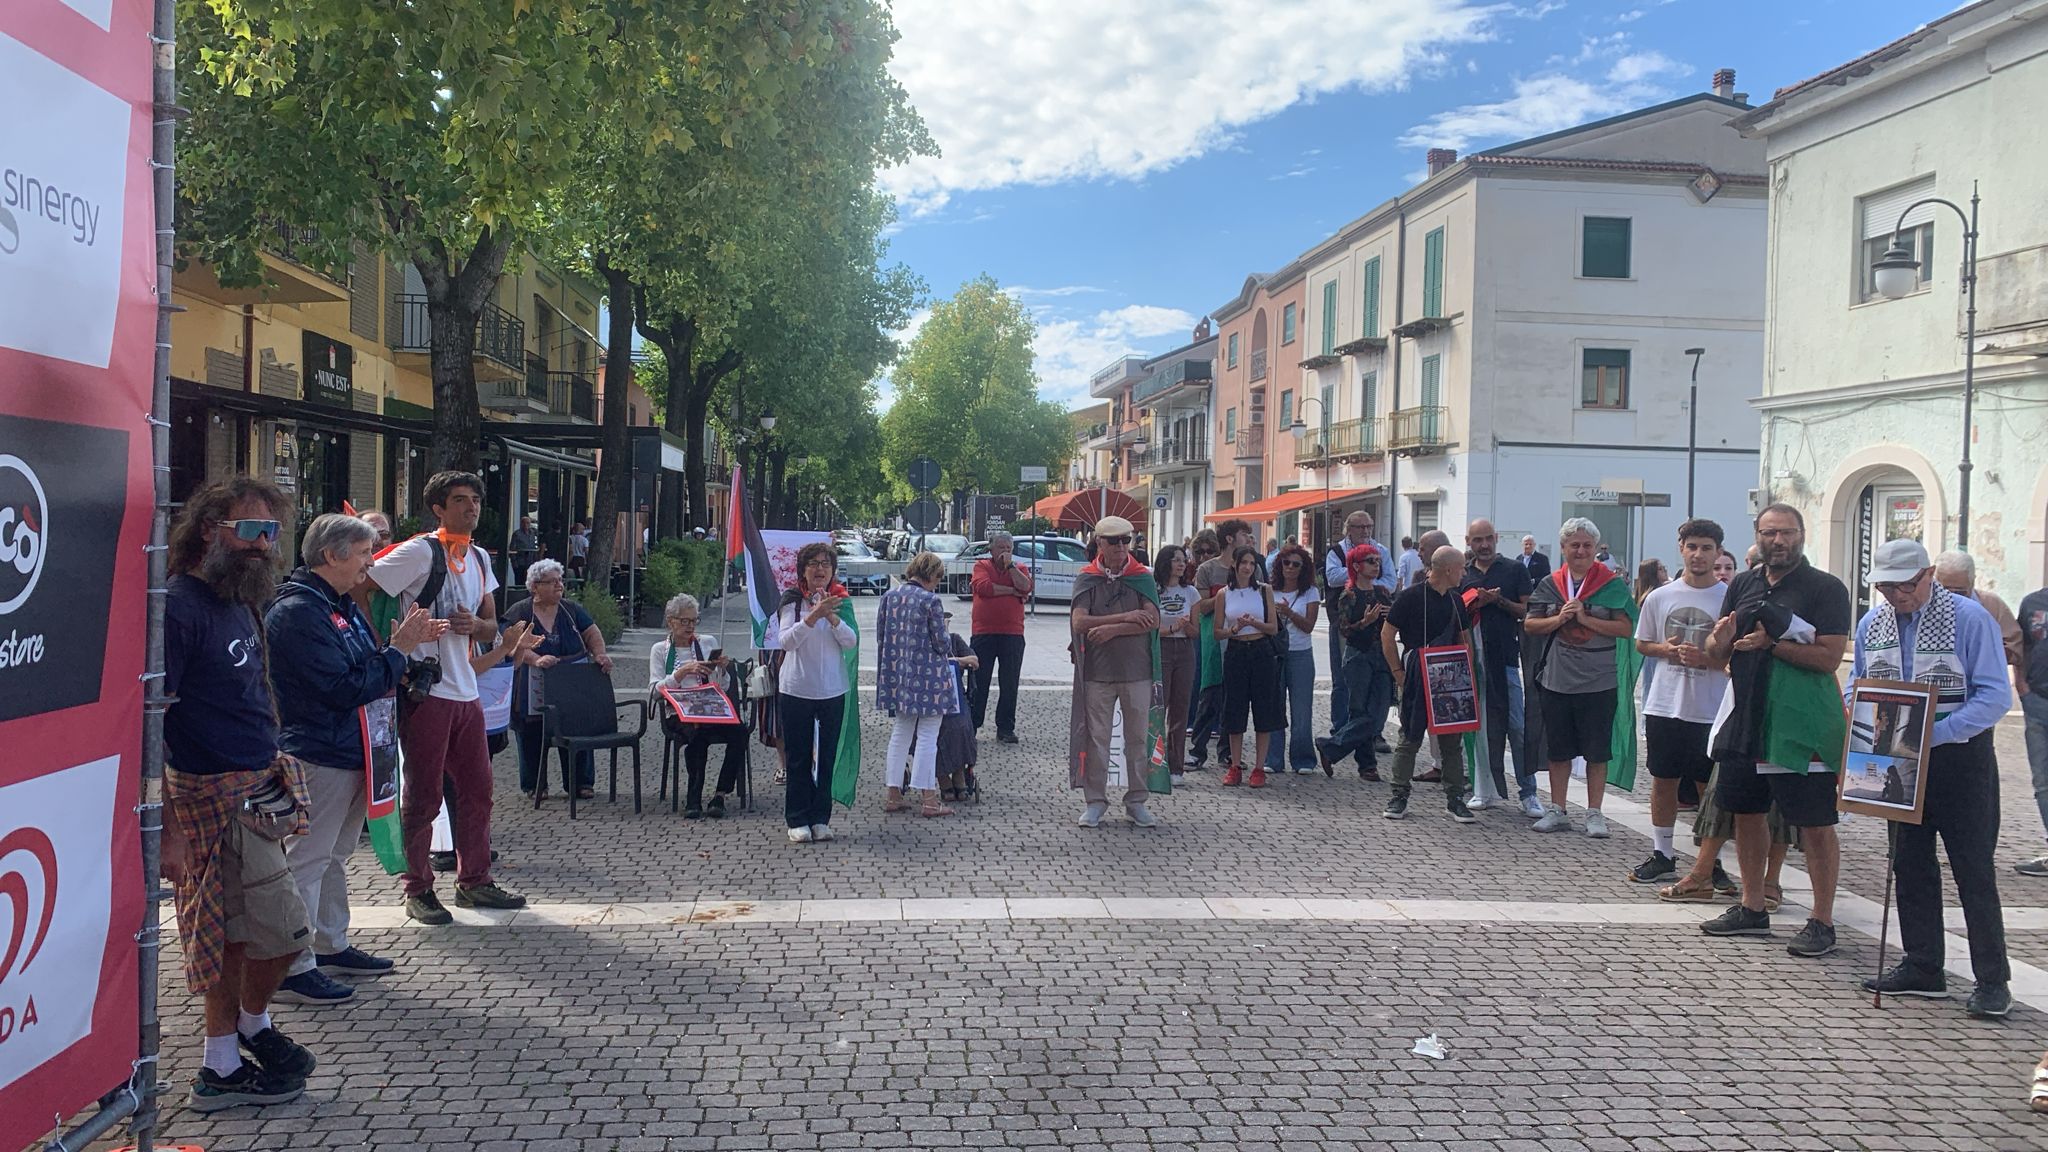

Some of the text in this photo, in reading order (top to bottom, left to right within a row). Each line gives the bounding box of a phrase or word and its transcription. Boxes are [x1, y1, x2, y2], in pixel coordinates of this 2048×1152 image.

[4, 168, 99, 247] sinergy
[318, 369, 348, 392] NUNC EST
